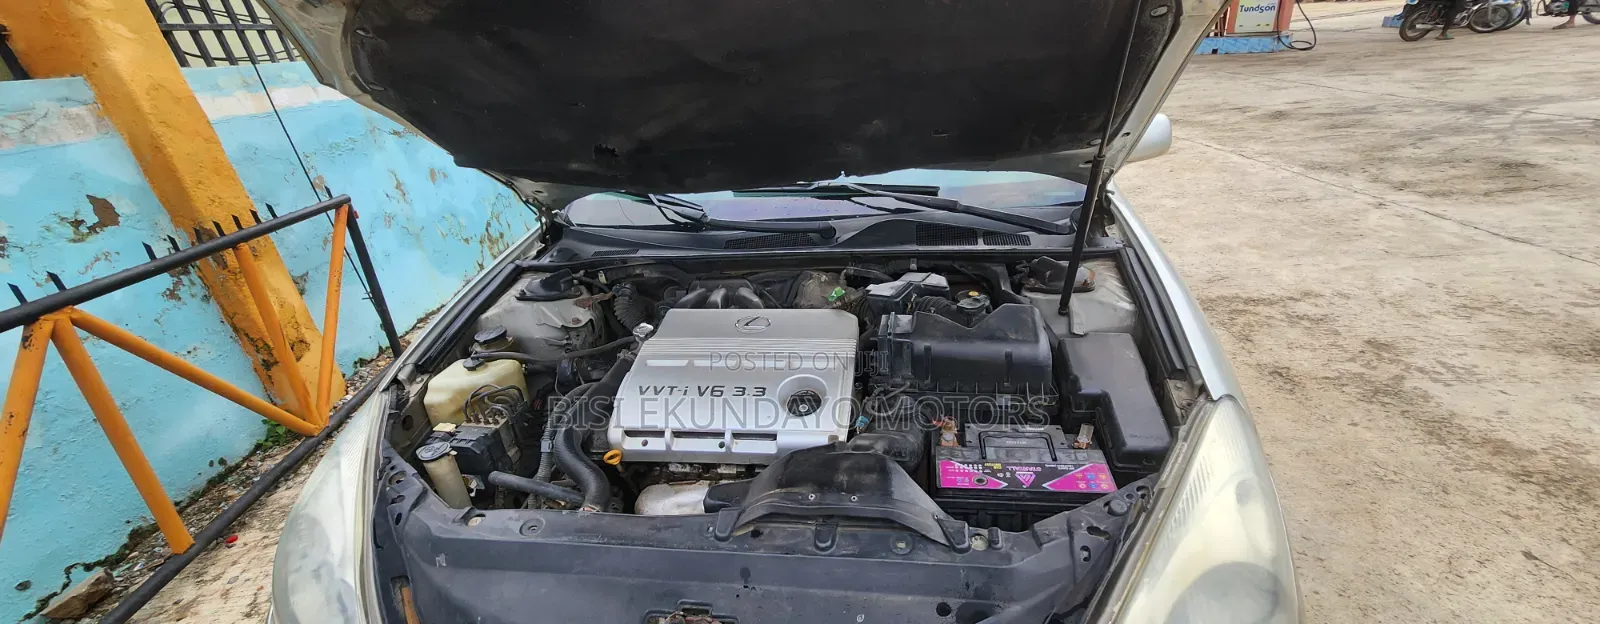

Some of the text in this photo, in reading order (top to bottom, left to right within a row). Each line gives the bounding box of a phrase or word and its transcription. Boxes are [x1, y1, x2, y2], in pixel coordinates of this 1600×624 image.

[1239, 4, 1276, 13] Tundson
[638, 385, 767, 398] VVT-i V6 3.3
